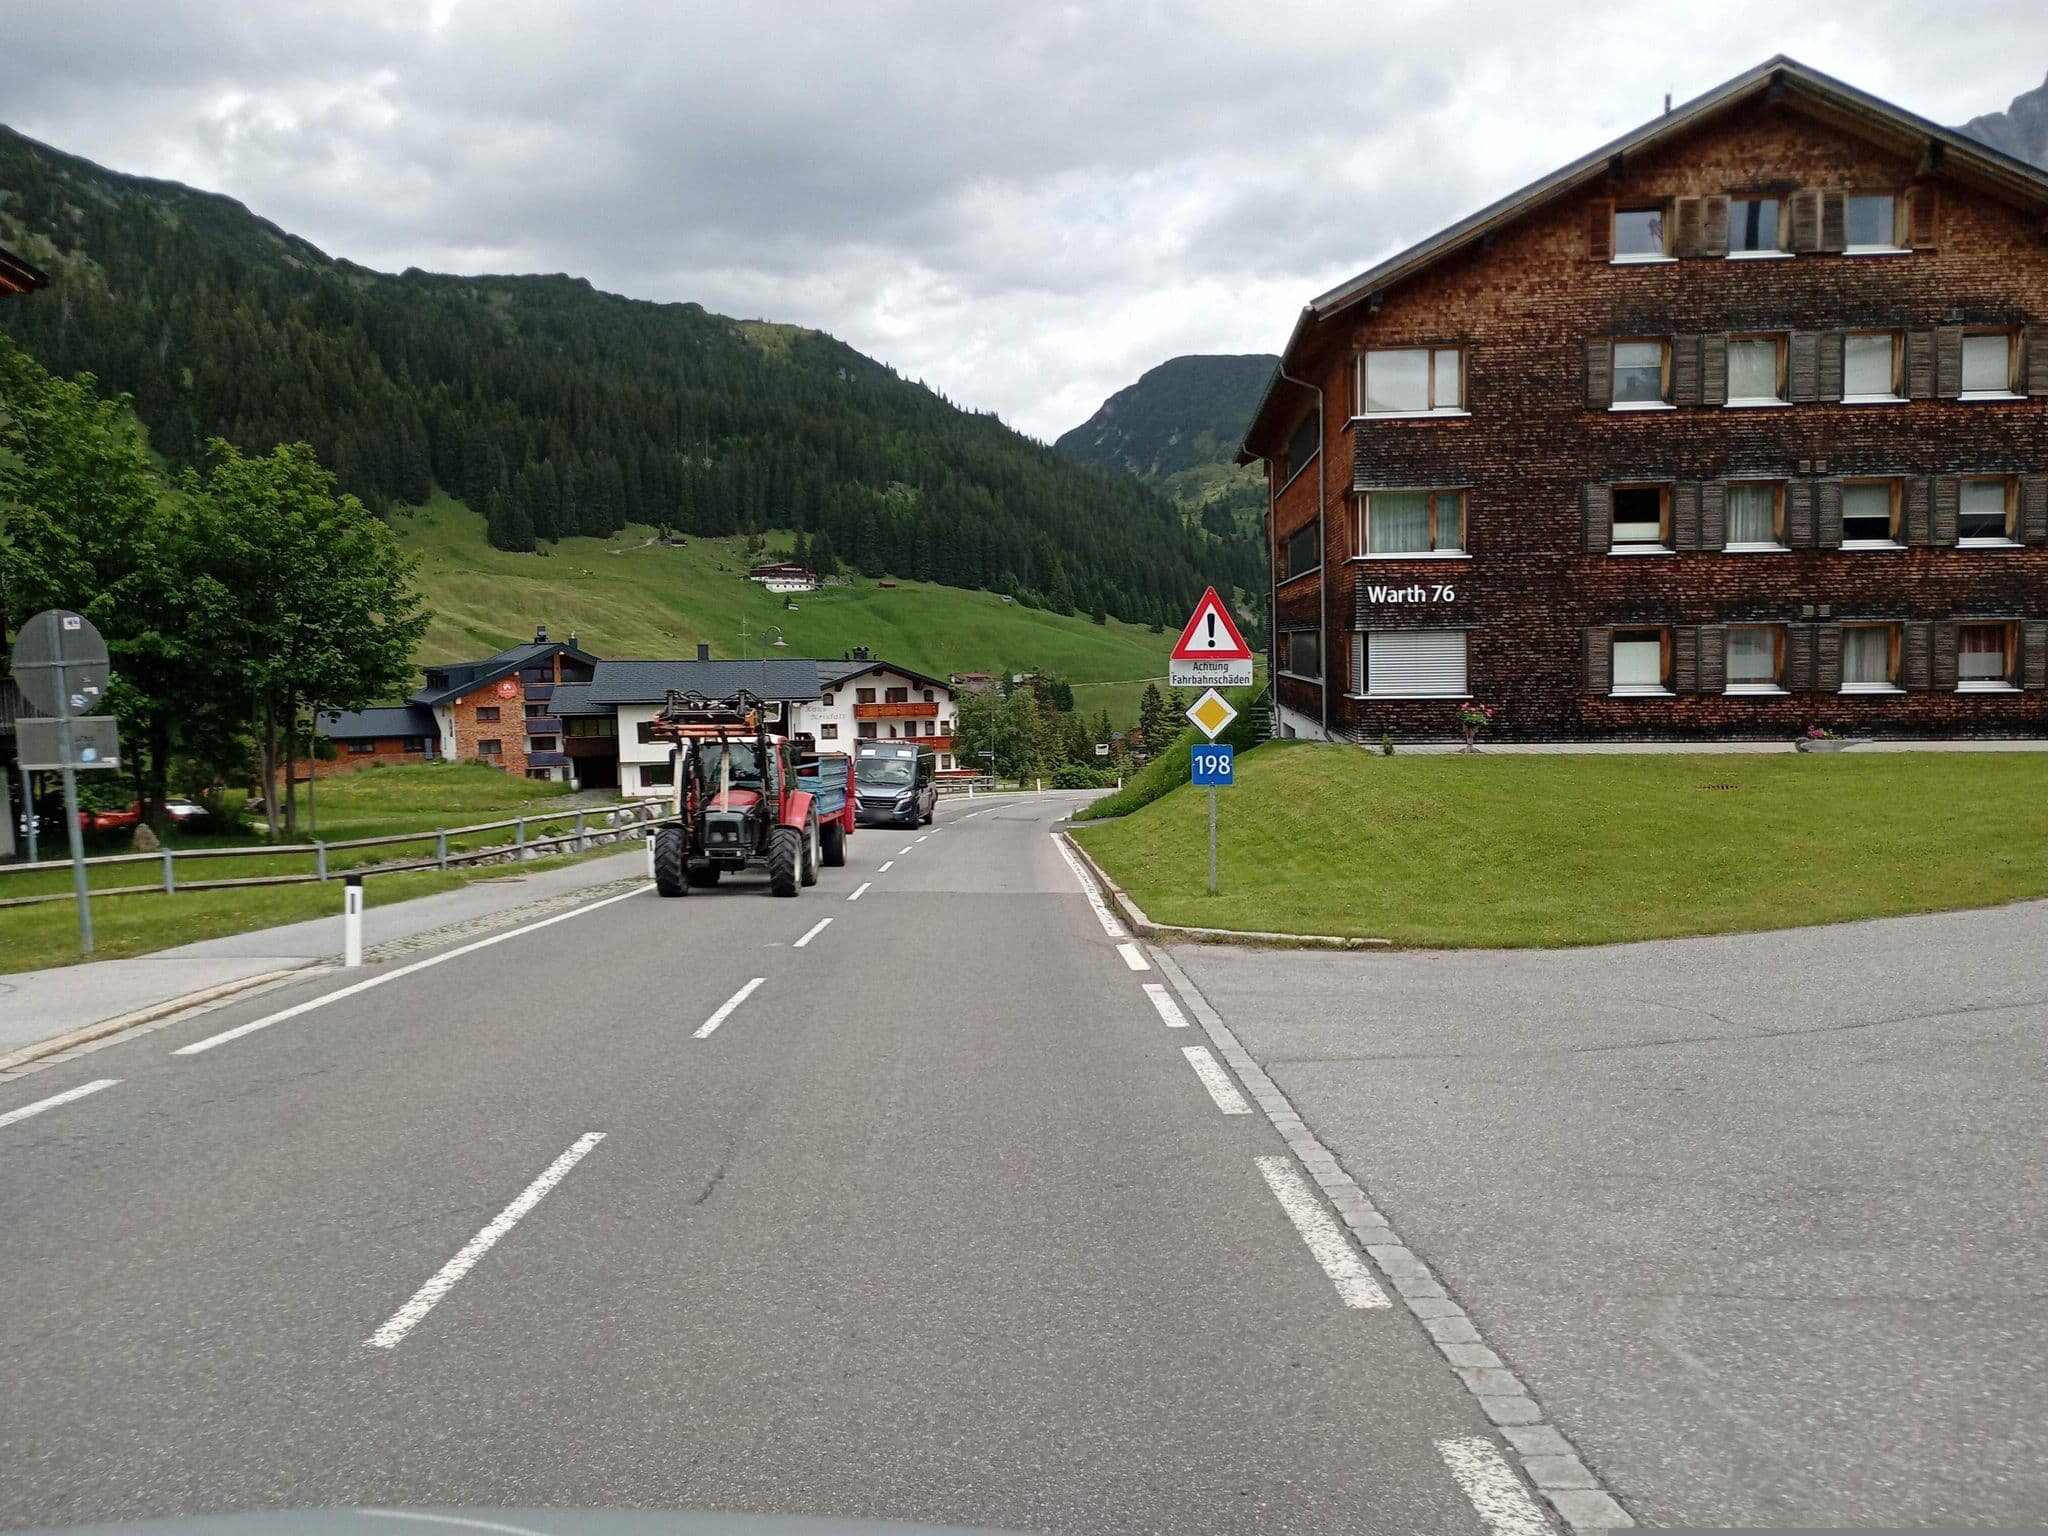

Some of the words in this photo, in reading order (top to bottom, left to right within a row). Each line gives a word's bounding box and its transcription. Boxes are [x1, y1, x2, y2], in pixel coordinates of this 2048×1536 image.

[1367, 584, 1426, 603] Warth
[1431, 584, 1455, 602] 76
[1192, 662, 1229, 673] Achtung
[1172, 674, 1250, 684] Fahrbahnschäden
[1195, 755, 1230, 775] 198
